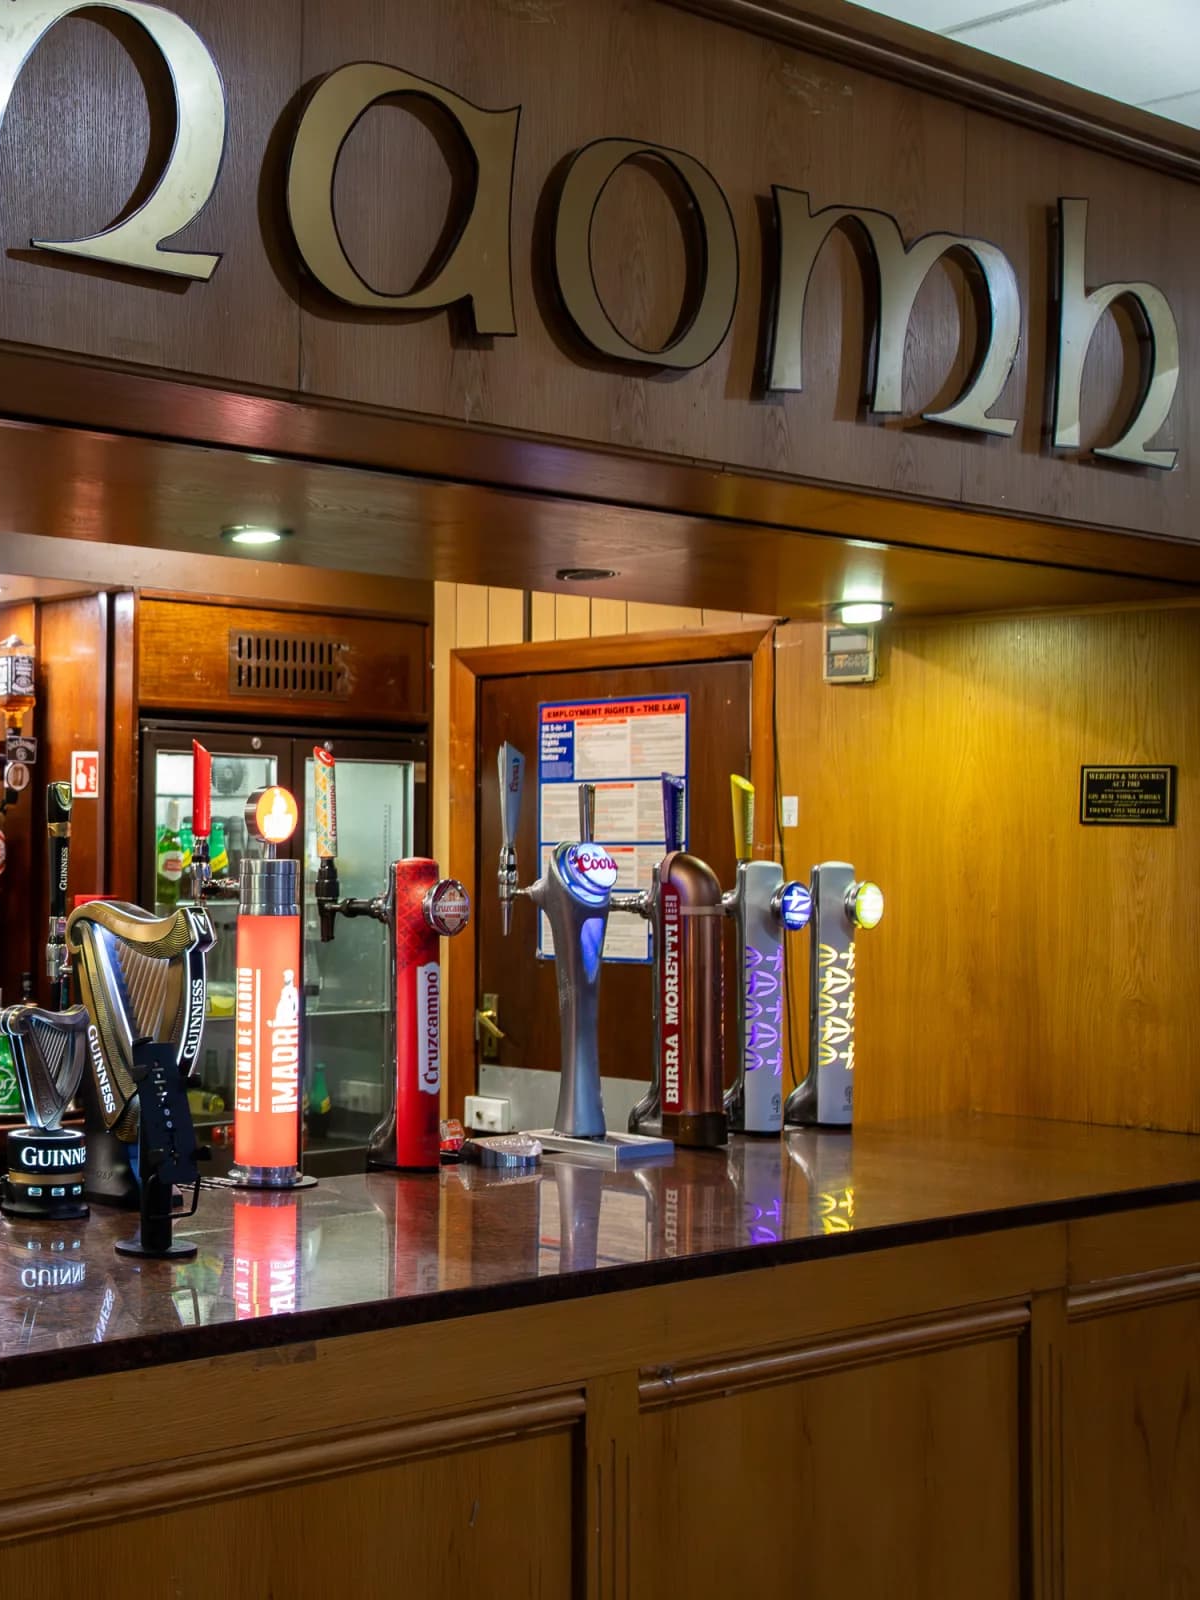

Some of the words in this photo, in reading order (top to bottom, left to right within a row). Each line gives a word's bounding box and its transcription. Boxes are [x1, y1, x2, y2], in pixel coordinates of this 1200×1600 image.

[547, 707, 602, 718] EMPLOYMENT
[604, 705, 635, 715] RIGHTS
[643, 703, 663, 713] THE
[665, 702, 681, 711] LAW
[59, 846, 69, 891] GUINNESS
[238, 967, 253, 1023] MADRID
[665, 924, 679, 1026] MORETTI
[183, 978, 203, 1059] GUINNESS
[238, 1028, 253, 1046] DE
[422, 970, 439, 1085] Cruzcampo
[87, 1024, 117, 1114] GUINNESS
[238, 1052, 252, 1091] ALMA
[665, 1032, 679, 1104] BIRRA
[238, 1096, 252, 1112] EL
